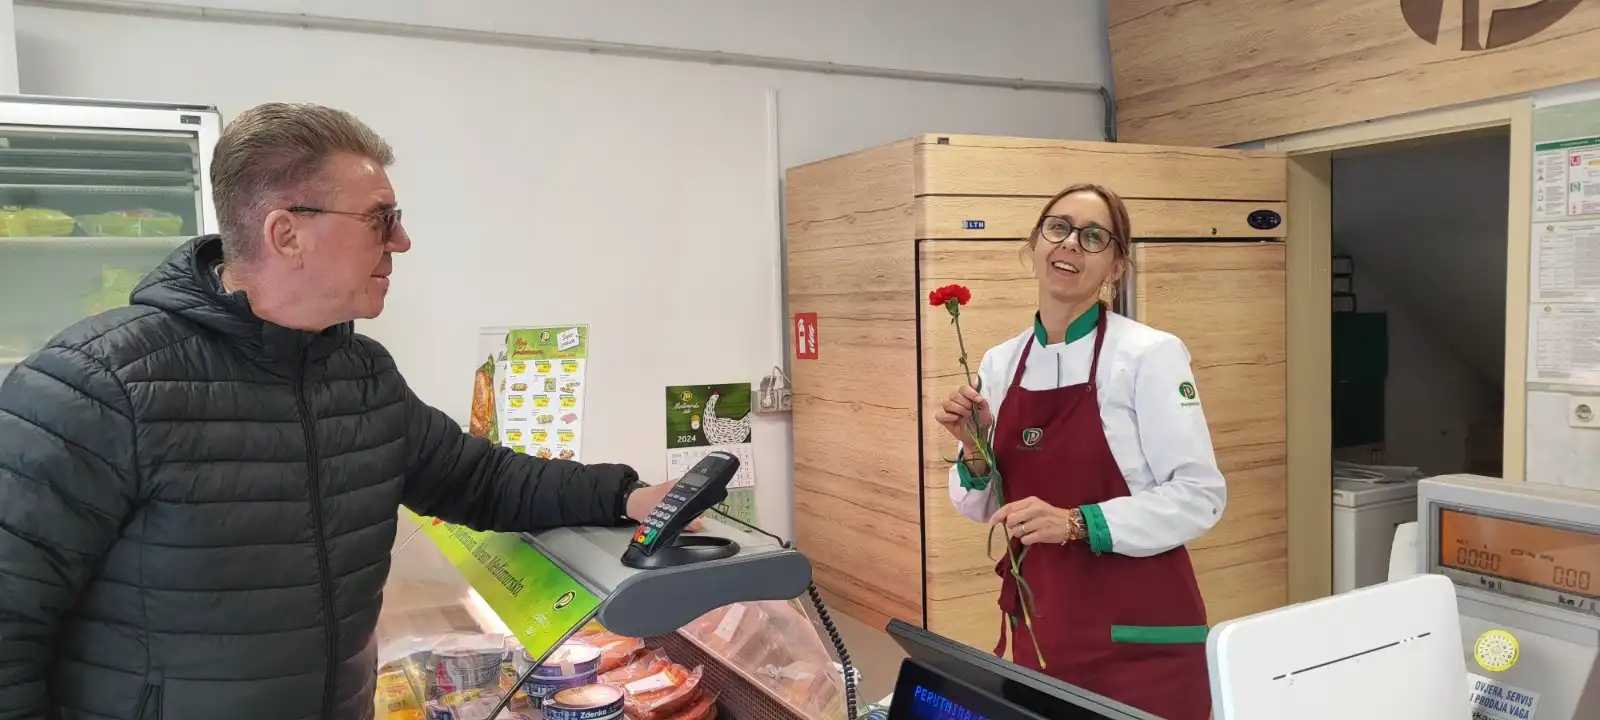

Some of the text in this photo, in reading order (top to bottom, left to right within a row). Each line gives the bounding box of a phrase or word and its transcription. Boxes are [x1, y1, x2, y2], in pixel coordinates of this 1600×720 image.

[677, 435, 697, 443] 2024
[1475, 681, 1534, 707] OVJERA, SERVIS
[580, 709, 607, 719] Zdenka
[1474, 694, 1507, 713] PRODAJA
[1509, 706, 1530, 720] VAGA
